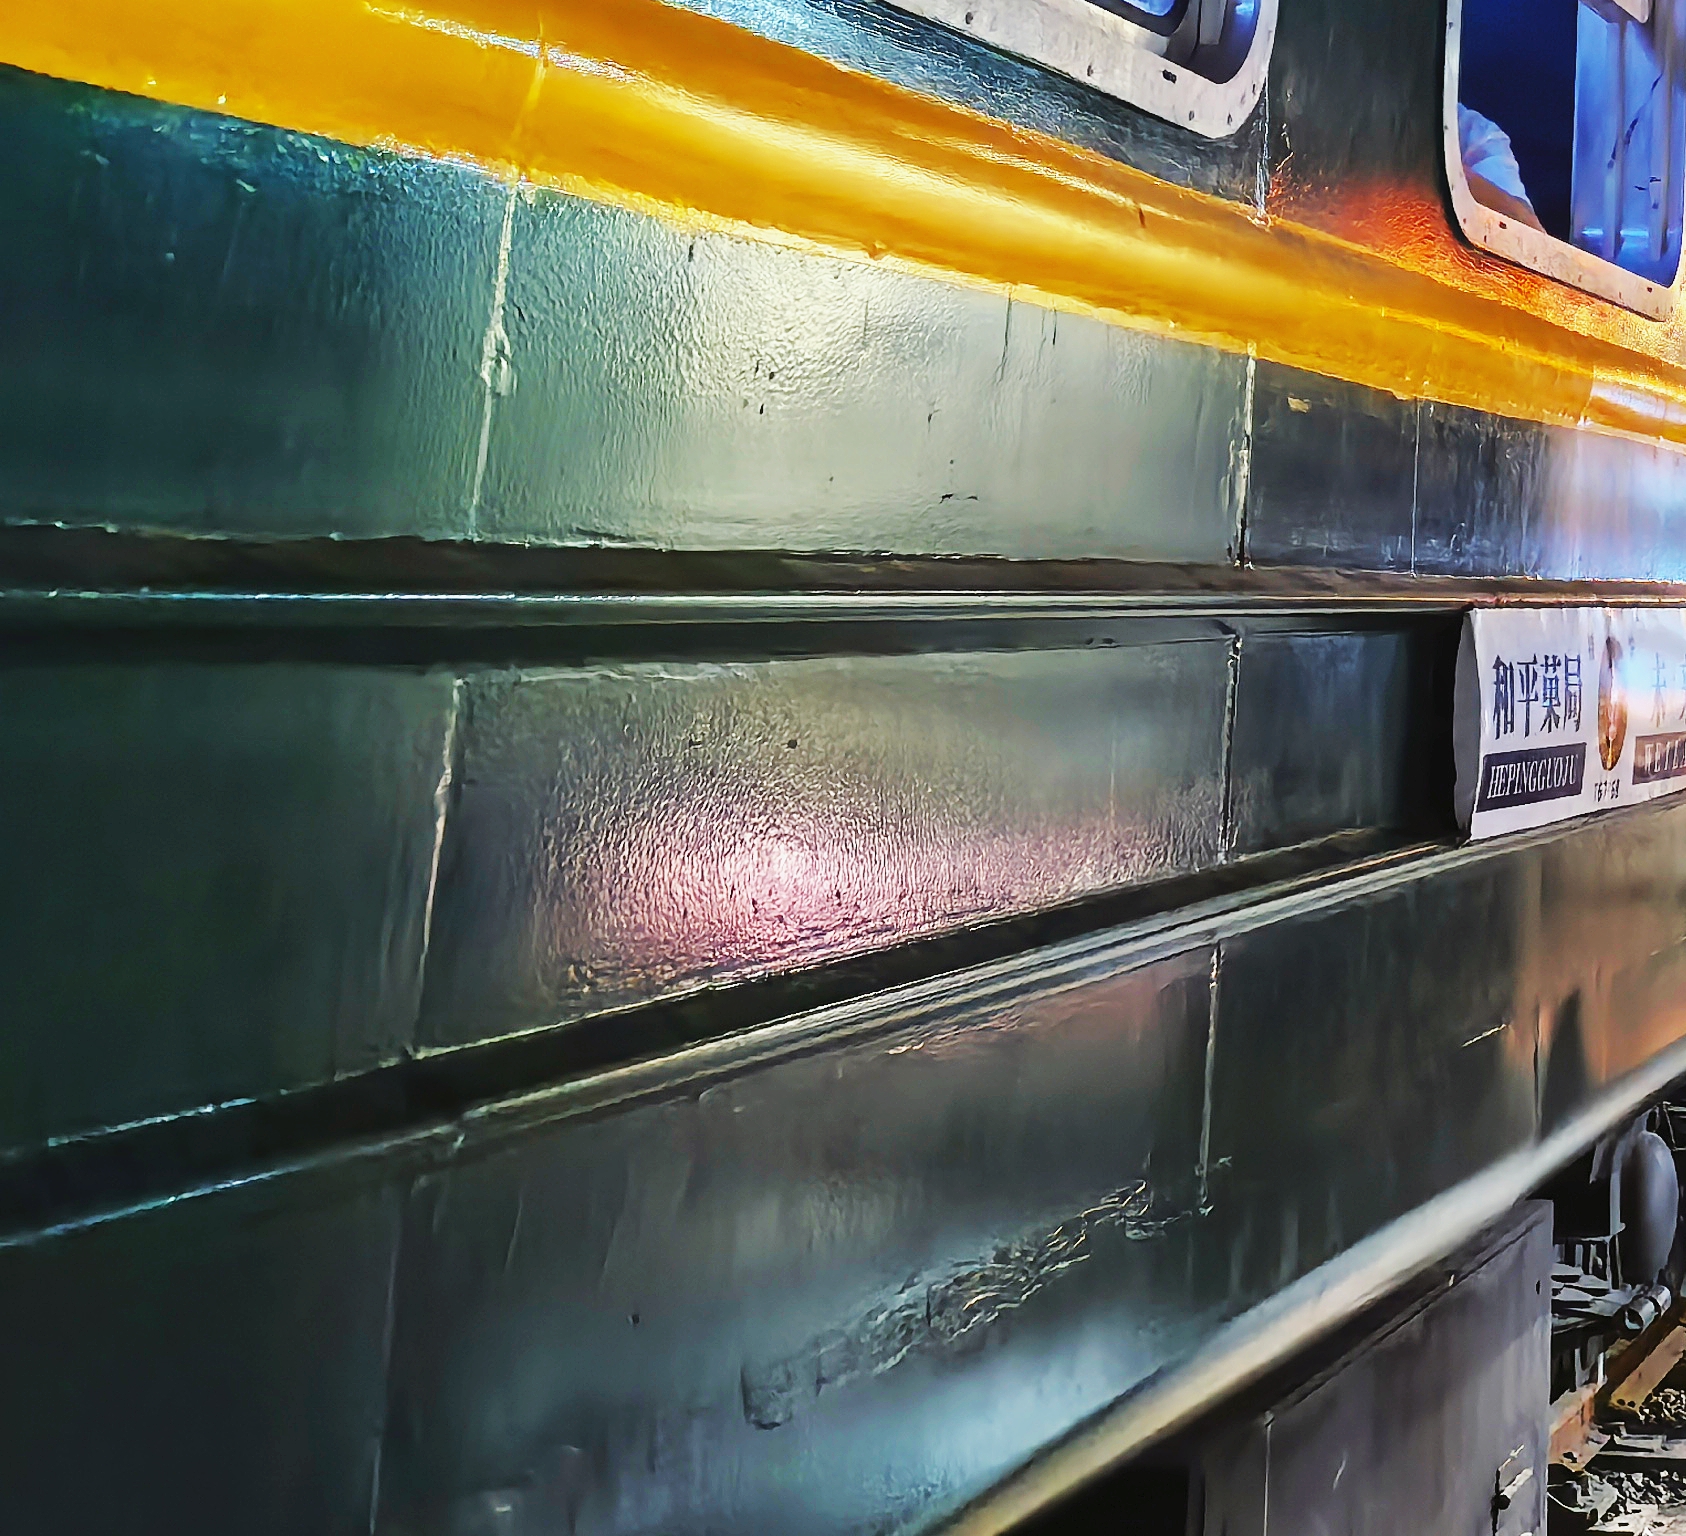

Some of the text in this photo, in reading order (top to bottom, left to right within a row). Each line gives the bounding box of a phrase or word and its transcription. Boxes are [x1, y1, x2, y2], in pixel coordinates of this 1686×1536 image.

[1492, 653, 1583, 740] 和平菓局
[1486, 753, 1579, 800] HEPINGGUOJU
